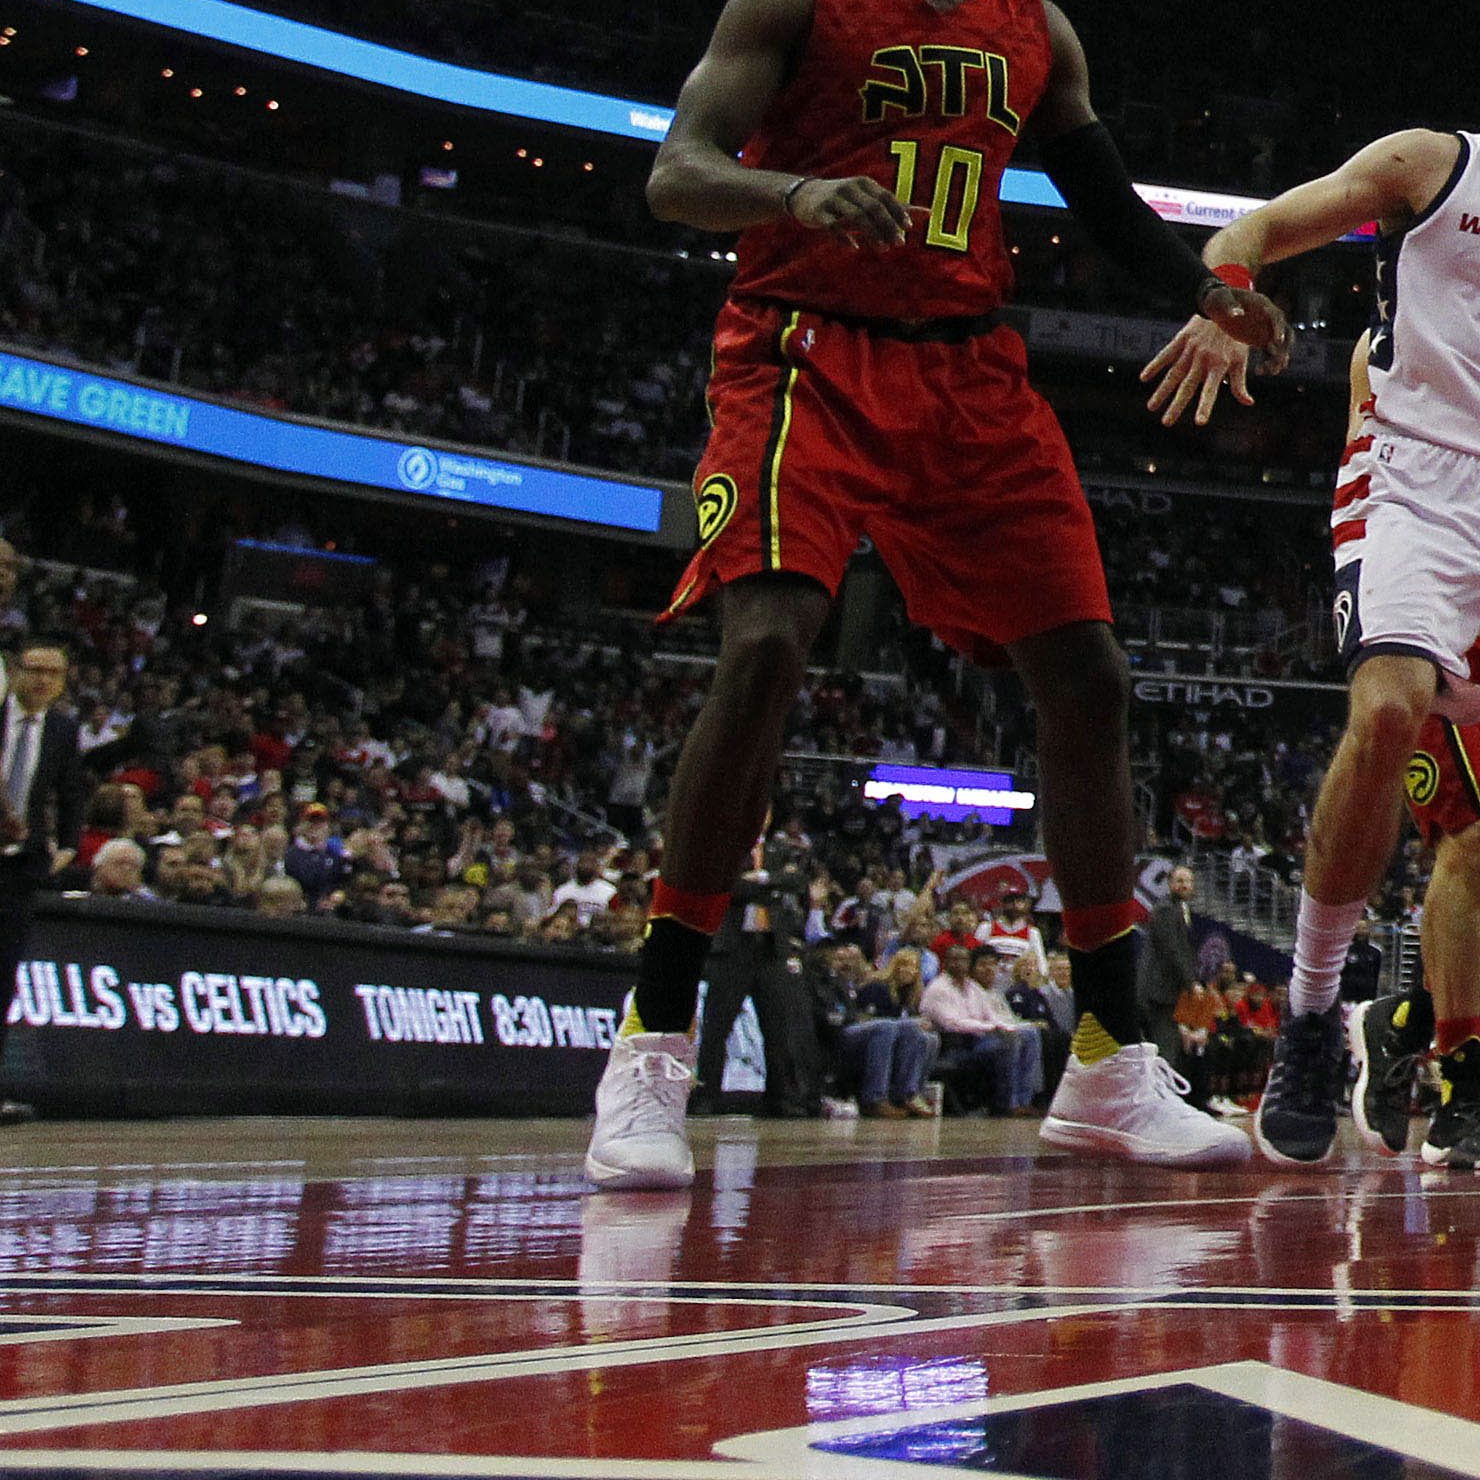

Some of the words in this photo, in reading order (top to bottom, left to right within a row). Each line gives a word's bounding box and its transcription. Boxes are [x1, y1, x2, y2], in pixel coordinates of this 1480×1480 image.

[860, 44, 1021, 136] ATL
[890, 140, 983, 252] 10
[1186, 200, 1234, 219] Current
[0, 360, 71, 411] AVE
[78, 383, 191, 439] GREEN
[1134, 680, 1275, 708] ETIHAD
[180, 970, 328, 1038] CELTICS
[354, 982, 486, 1045] TONIGHT
